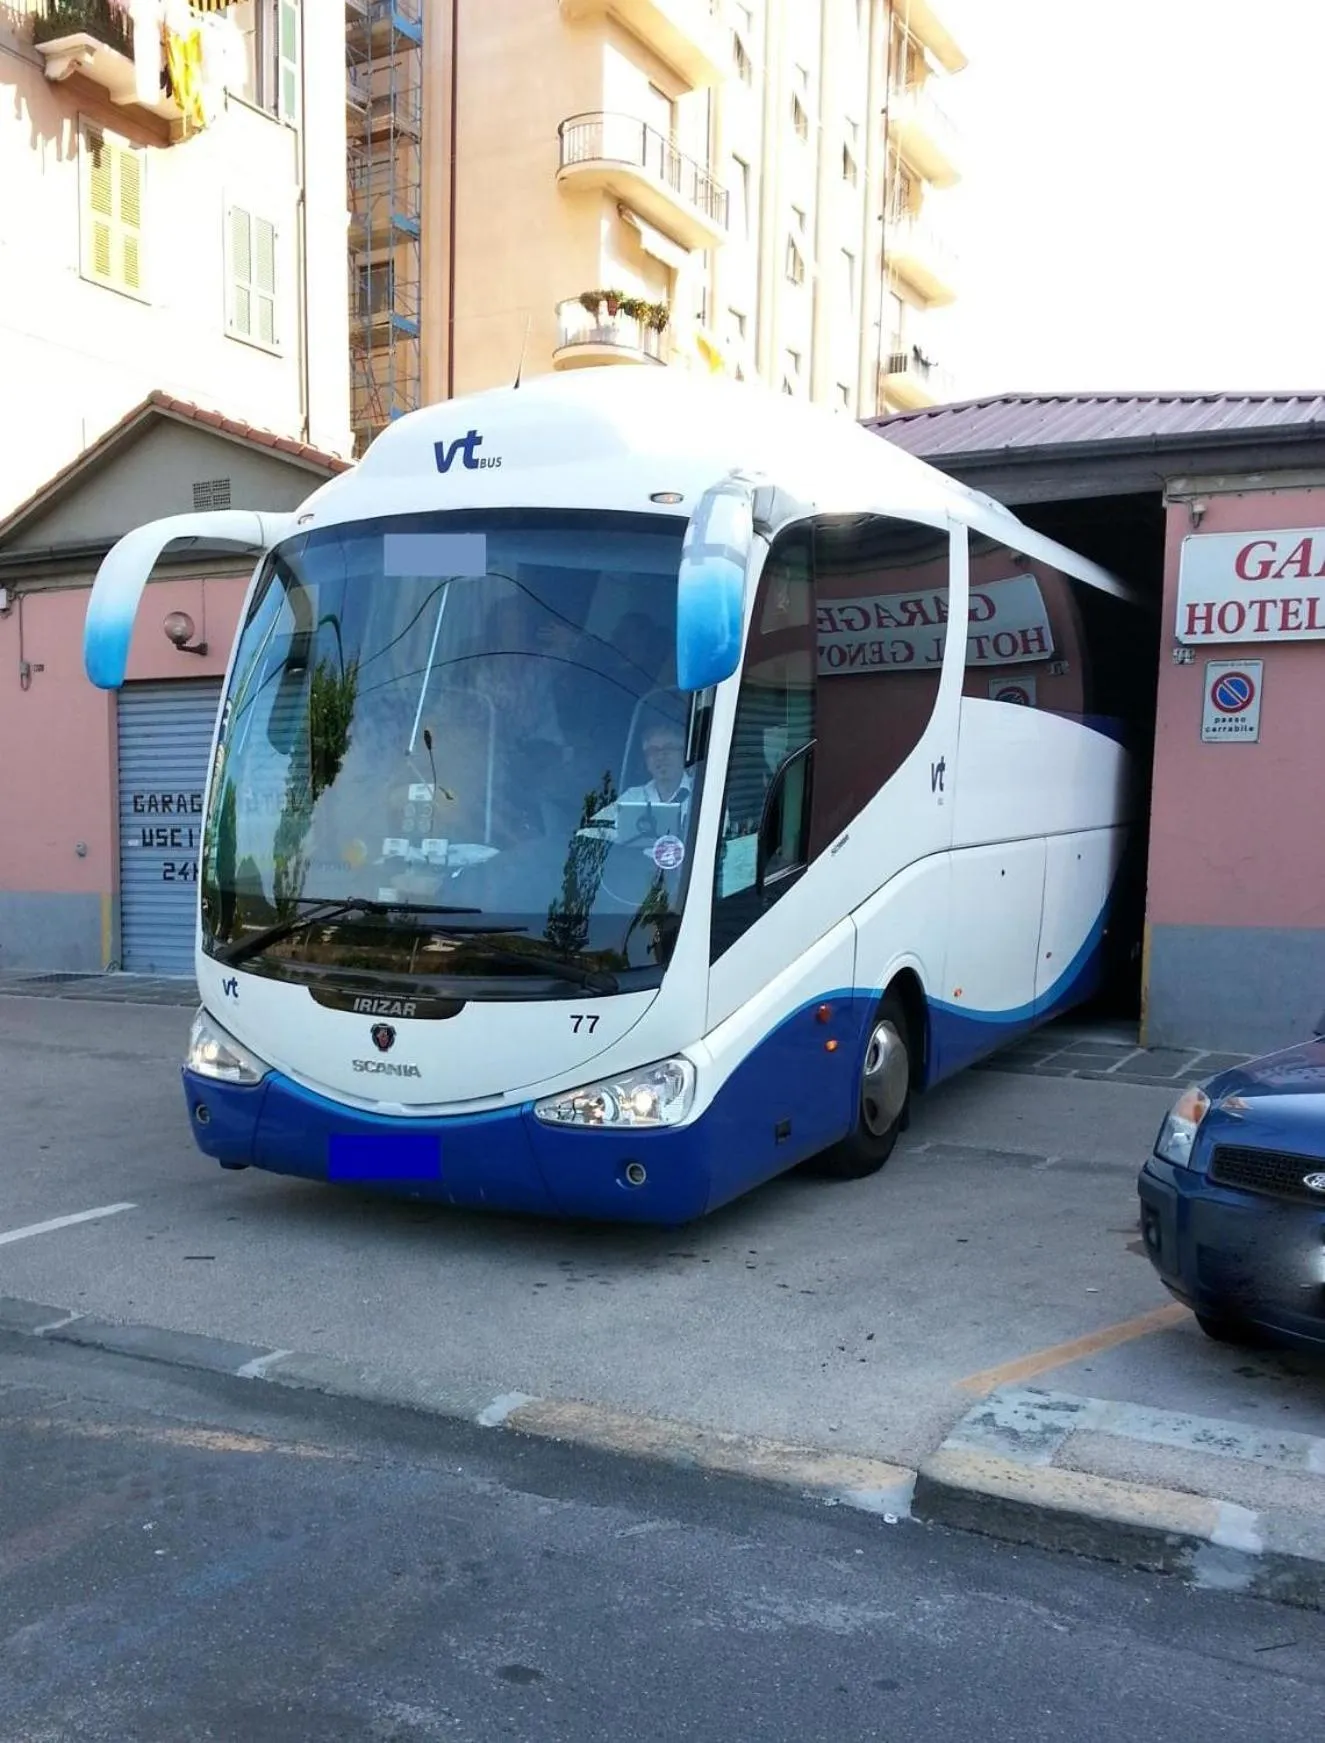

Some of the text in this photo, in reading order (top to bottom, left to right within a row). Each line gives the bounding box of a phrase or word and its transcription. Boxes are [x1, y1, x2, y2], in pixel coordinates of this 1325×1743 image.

[480, 457, 502, 469] BUS
[1235, 538, 1325, 581] GA
[353, 998, 417, 1016] IRIZAR
[570, 1015, 600, 1034] 77
[352, 1060, 422, 1078] SCANIA
